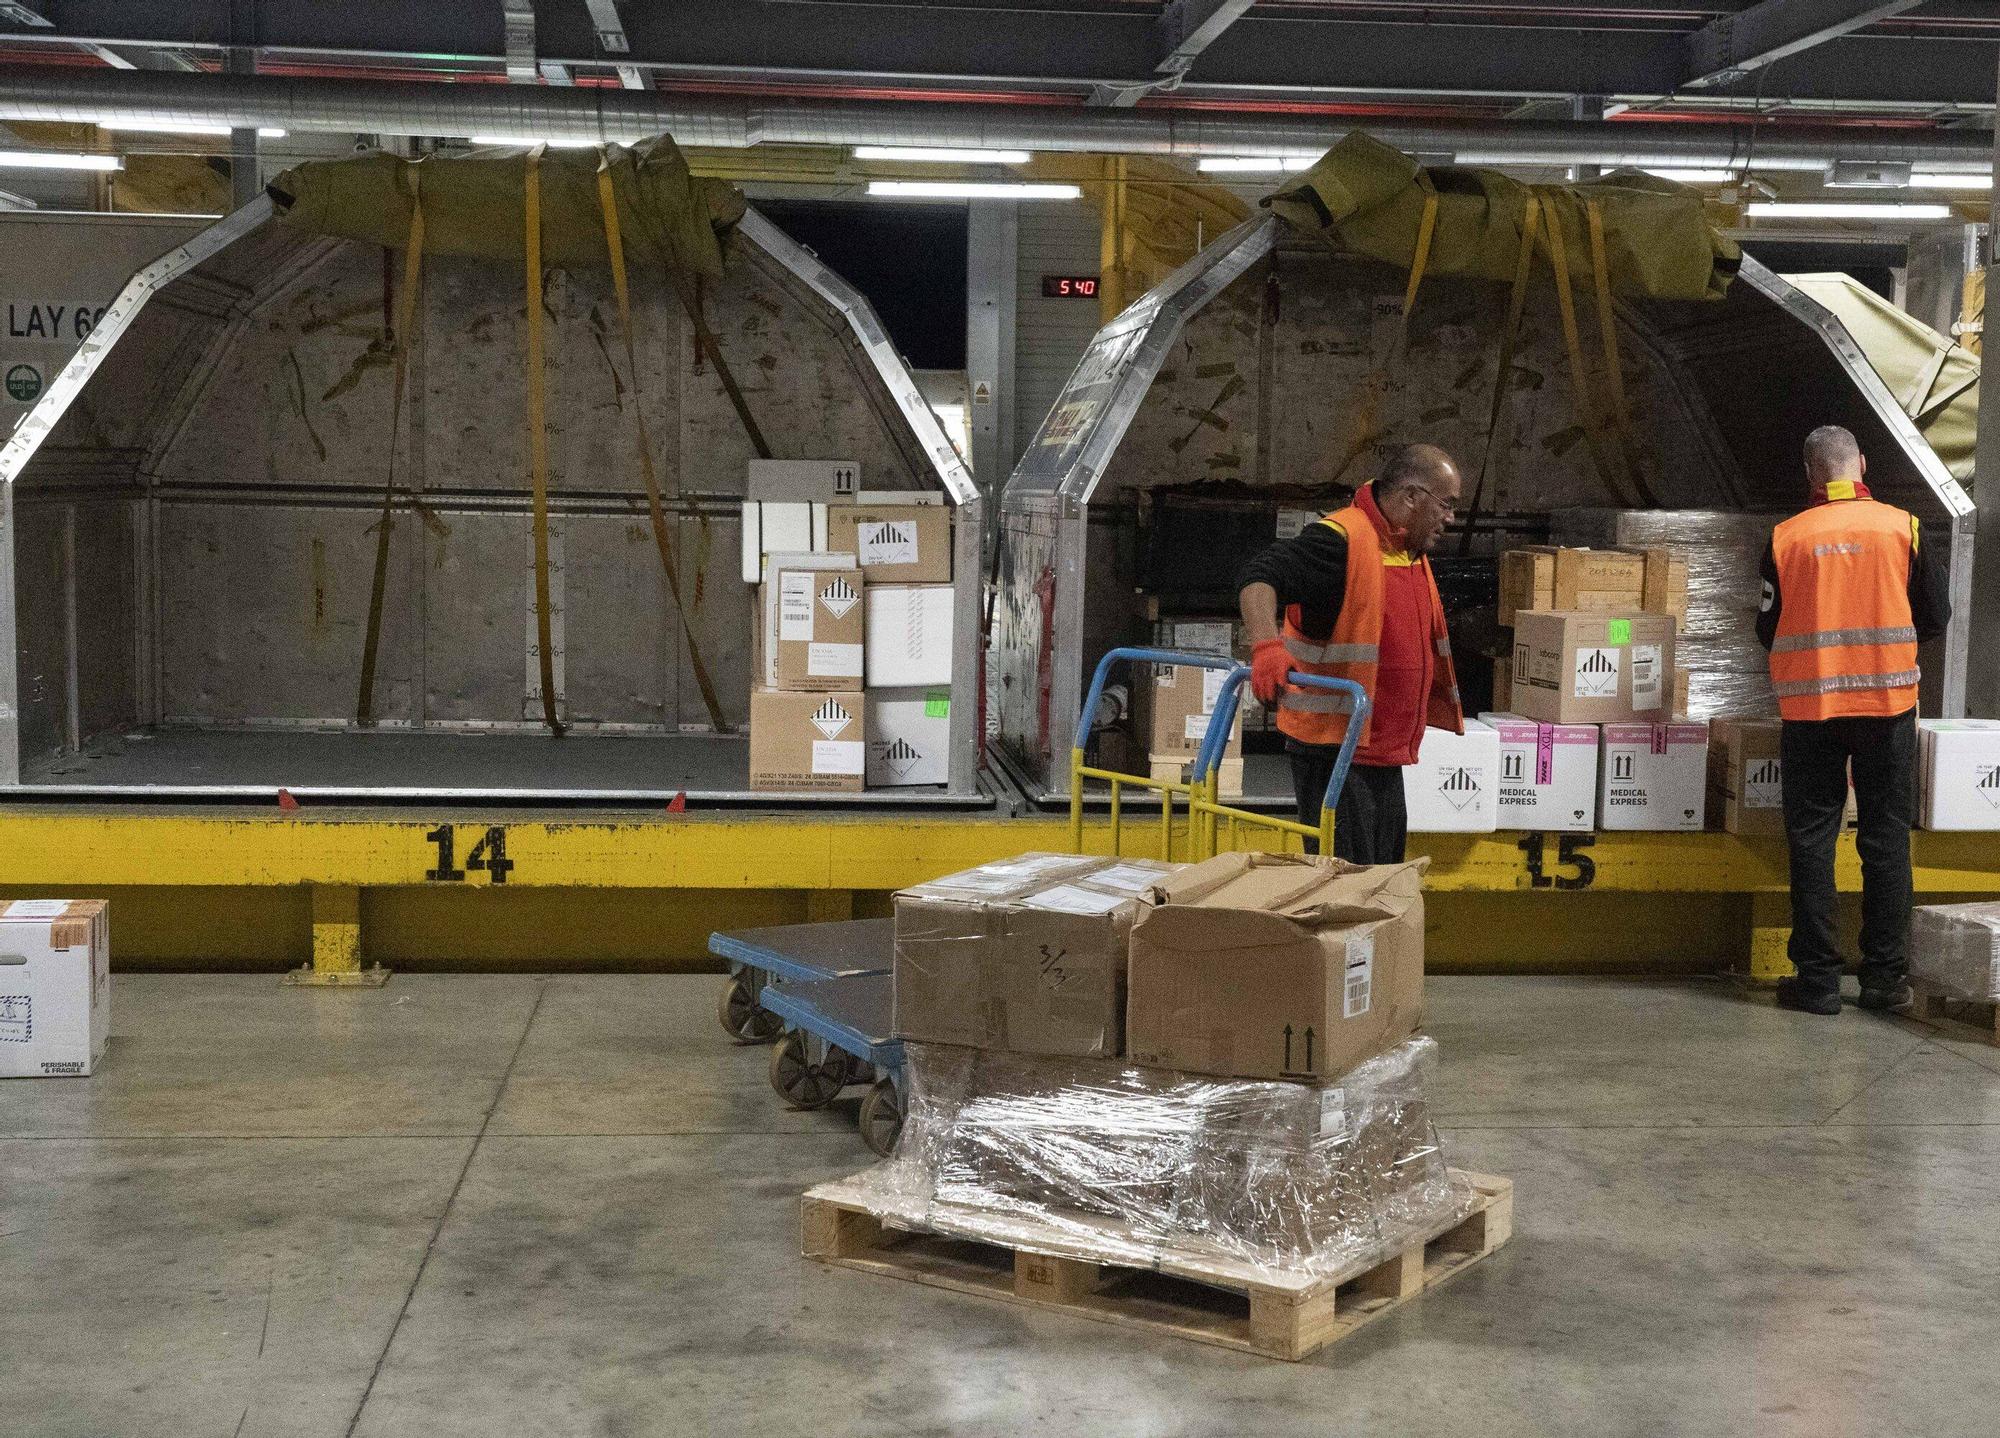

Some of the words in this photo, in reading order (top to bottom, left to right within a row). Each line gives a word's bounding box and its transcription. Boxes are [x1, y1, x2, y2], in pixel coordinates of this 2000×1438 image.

[9, 304, 65, 338] LAY
[1500, 788, 1537, 796] MEDICAL
[1609, 798, 1648, 806] EXPRESS
[1610, 789, 1648, 797] MEDICAL
[426, 825, 514, 883] 14
[1517, 832, 1596, 890] 15
